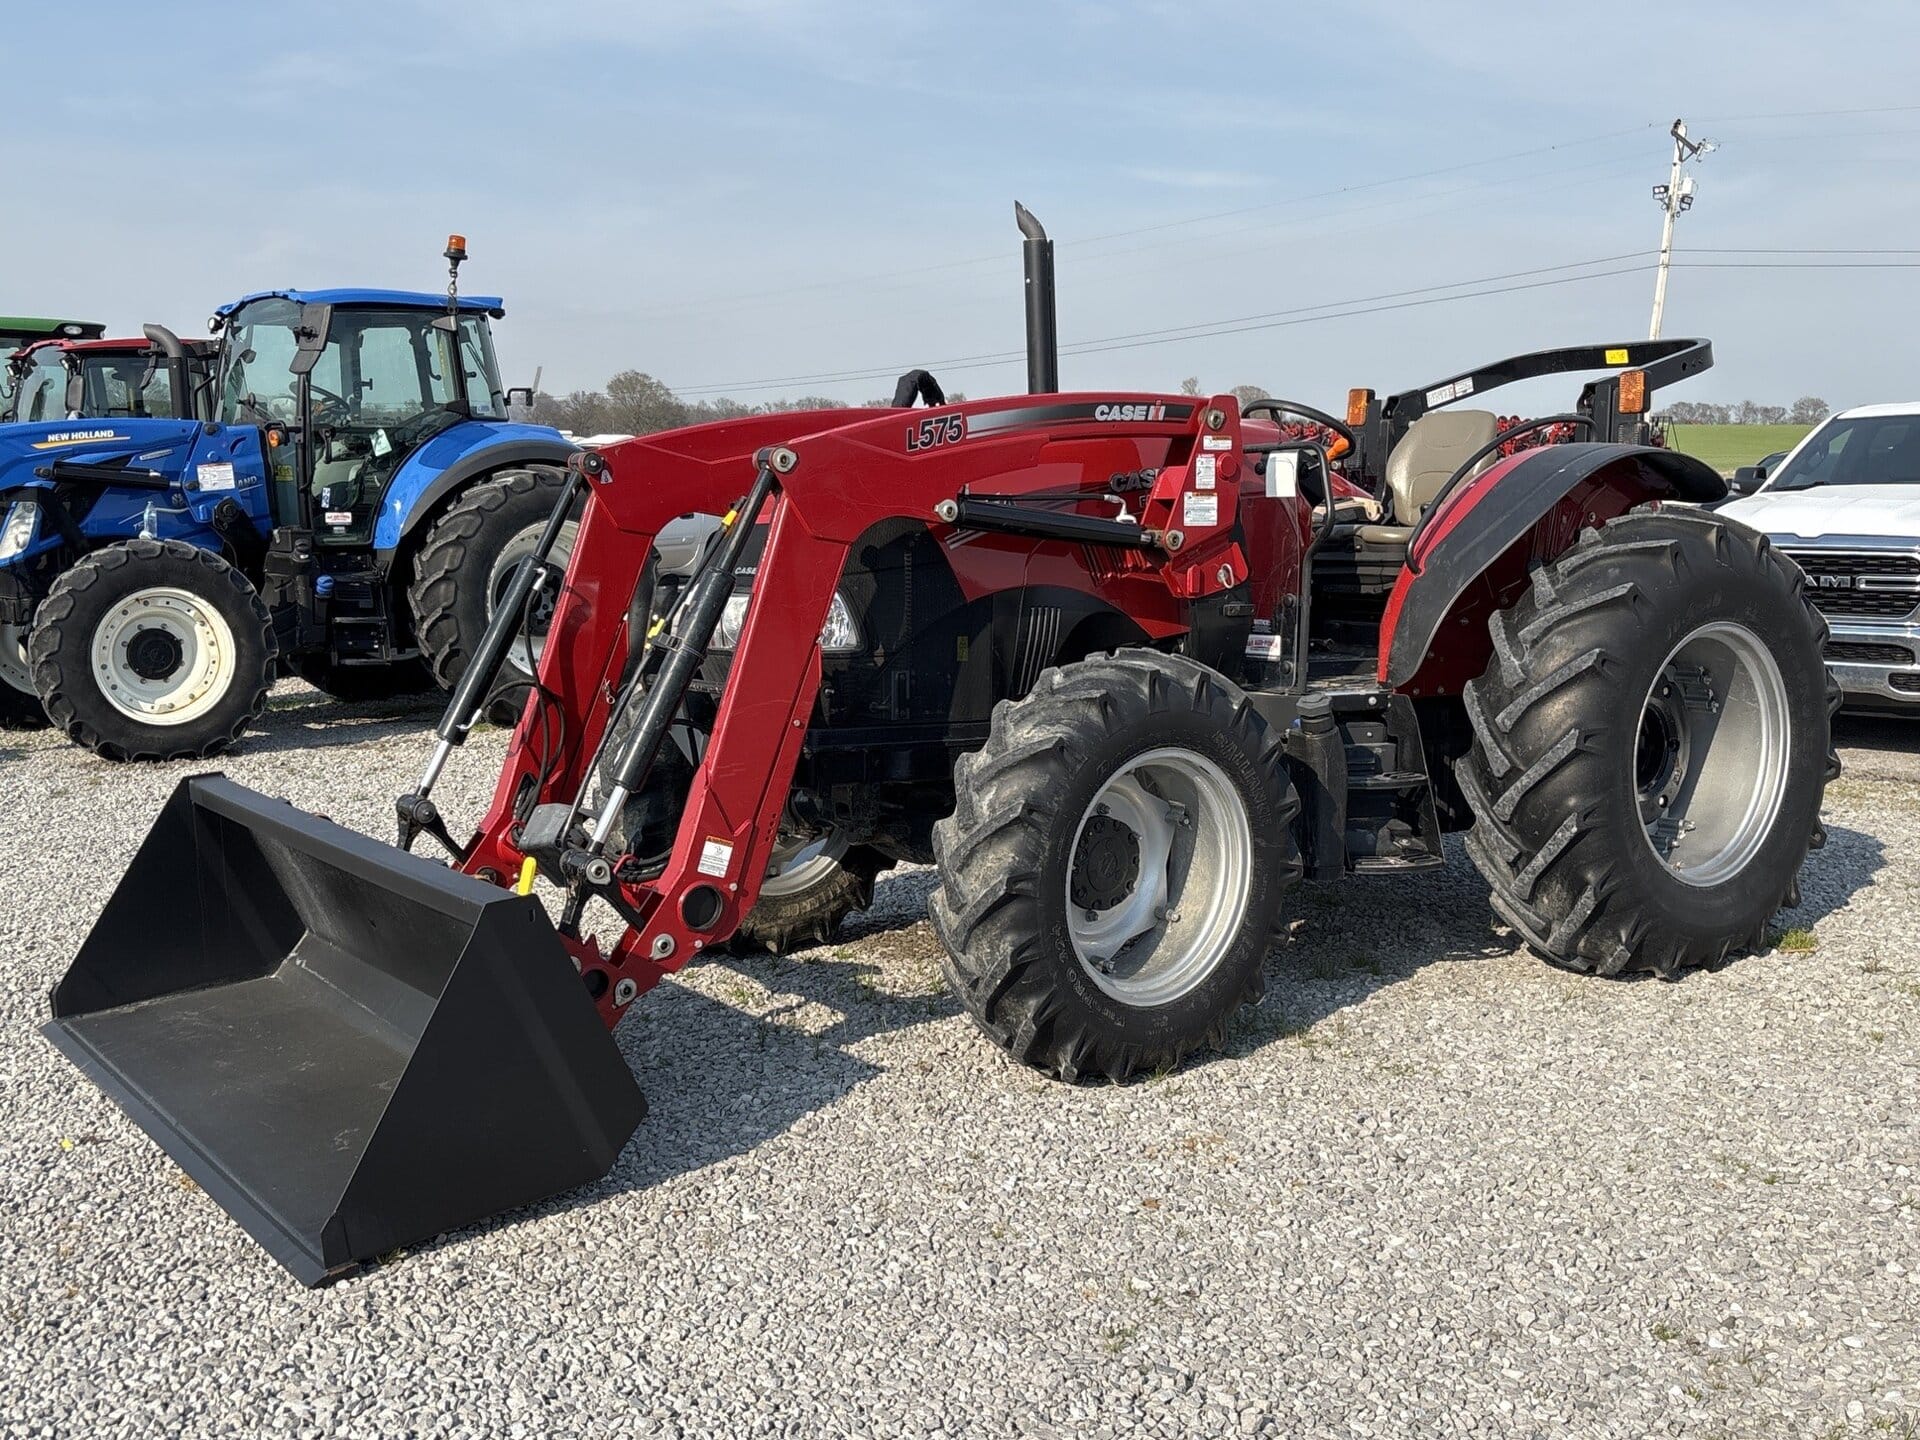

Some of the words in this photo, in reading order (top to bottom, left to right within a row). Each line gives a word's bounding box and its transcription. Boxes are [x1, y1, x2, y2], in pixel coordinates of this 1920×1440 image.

[1094, 405, 1147, 422] CASE
[47, 433, 69, 443] NEW
[71, 429, 115, 440] HOLLAND
[906, 413, 963, 453] L575
[1110, 468, 1160, 493] CAS
[1805, 575, 1851, 588] AM
